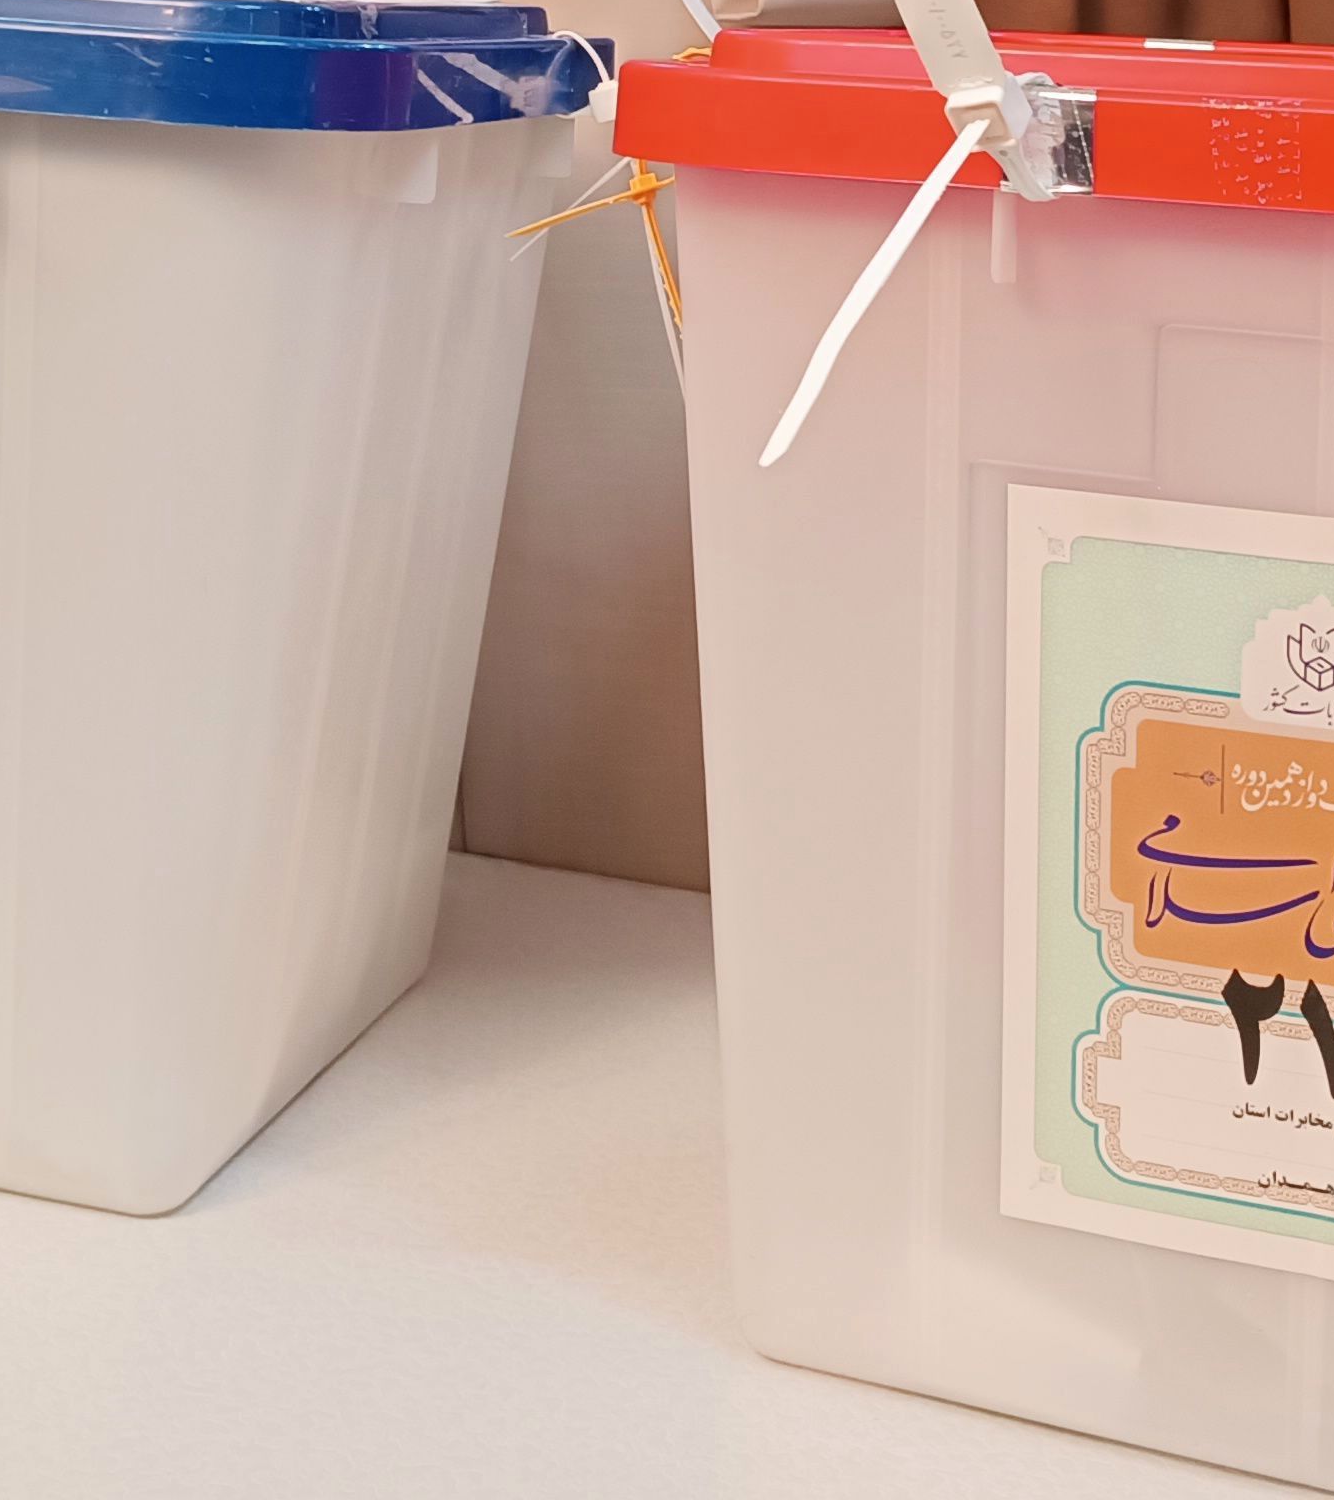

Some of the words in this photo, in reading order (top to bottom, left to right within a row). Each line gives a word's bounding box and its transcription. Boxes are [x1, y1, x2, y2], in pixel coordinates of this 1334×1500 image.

[1263, 684, 1300, 712] کشور
[1231, 763, 1267, 786] دوره
[1240, 761, 1328, 812] دوازدهمین
[1231, 1102, 1271, 1119] استان
[1273, 1108, 1333, 1130] مخابرات
